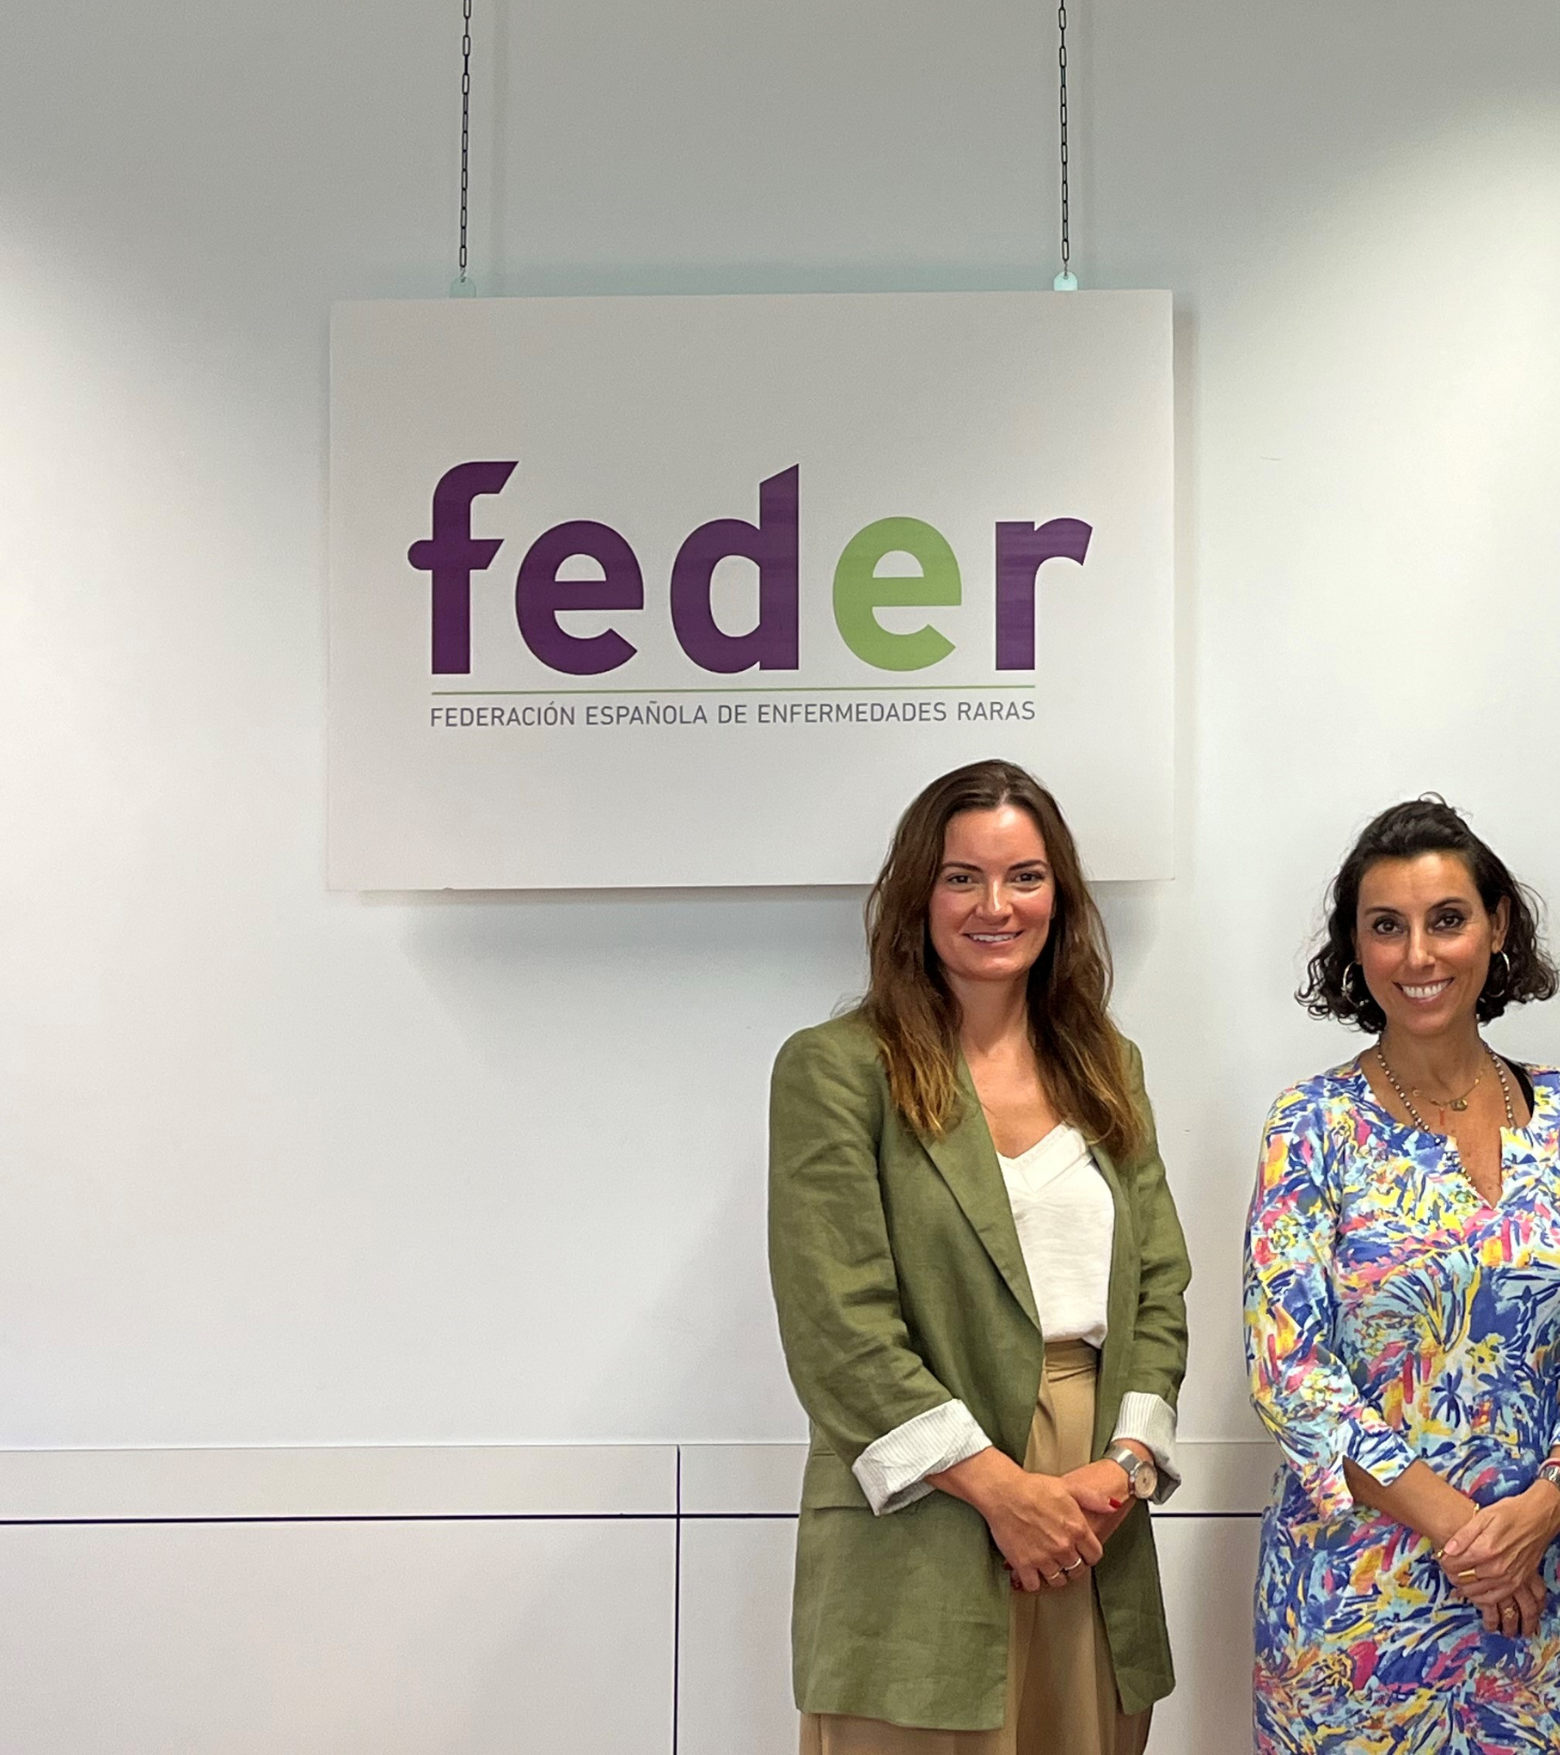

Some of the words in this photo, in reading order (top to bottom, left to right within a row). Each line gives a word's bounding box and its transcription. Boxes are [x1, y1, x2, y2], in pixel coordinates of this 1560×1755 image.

[408, 460, 1094, 676] feder
[430, 701, 575, 728] FEDERACIÓN
[585, 700, 709, 726] ESPAÑOLA
[717, 704, 748, 724] DE
[757, 701, 947, 724] ENFERMEDADES
[957, 700, 1036, 721] RARAS
